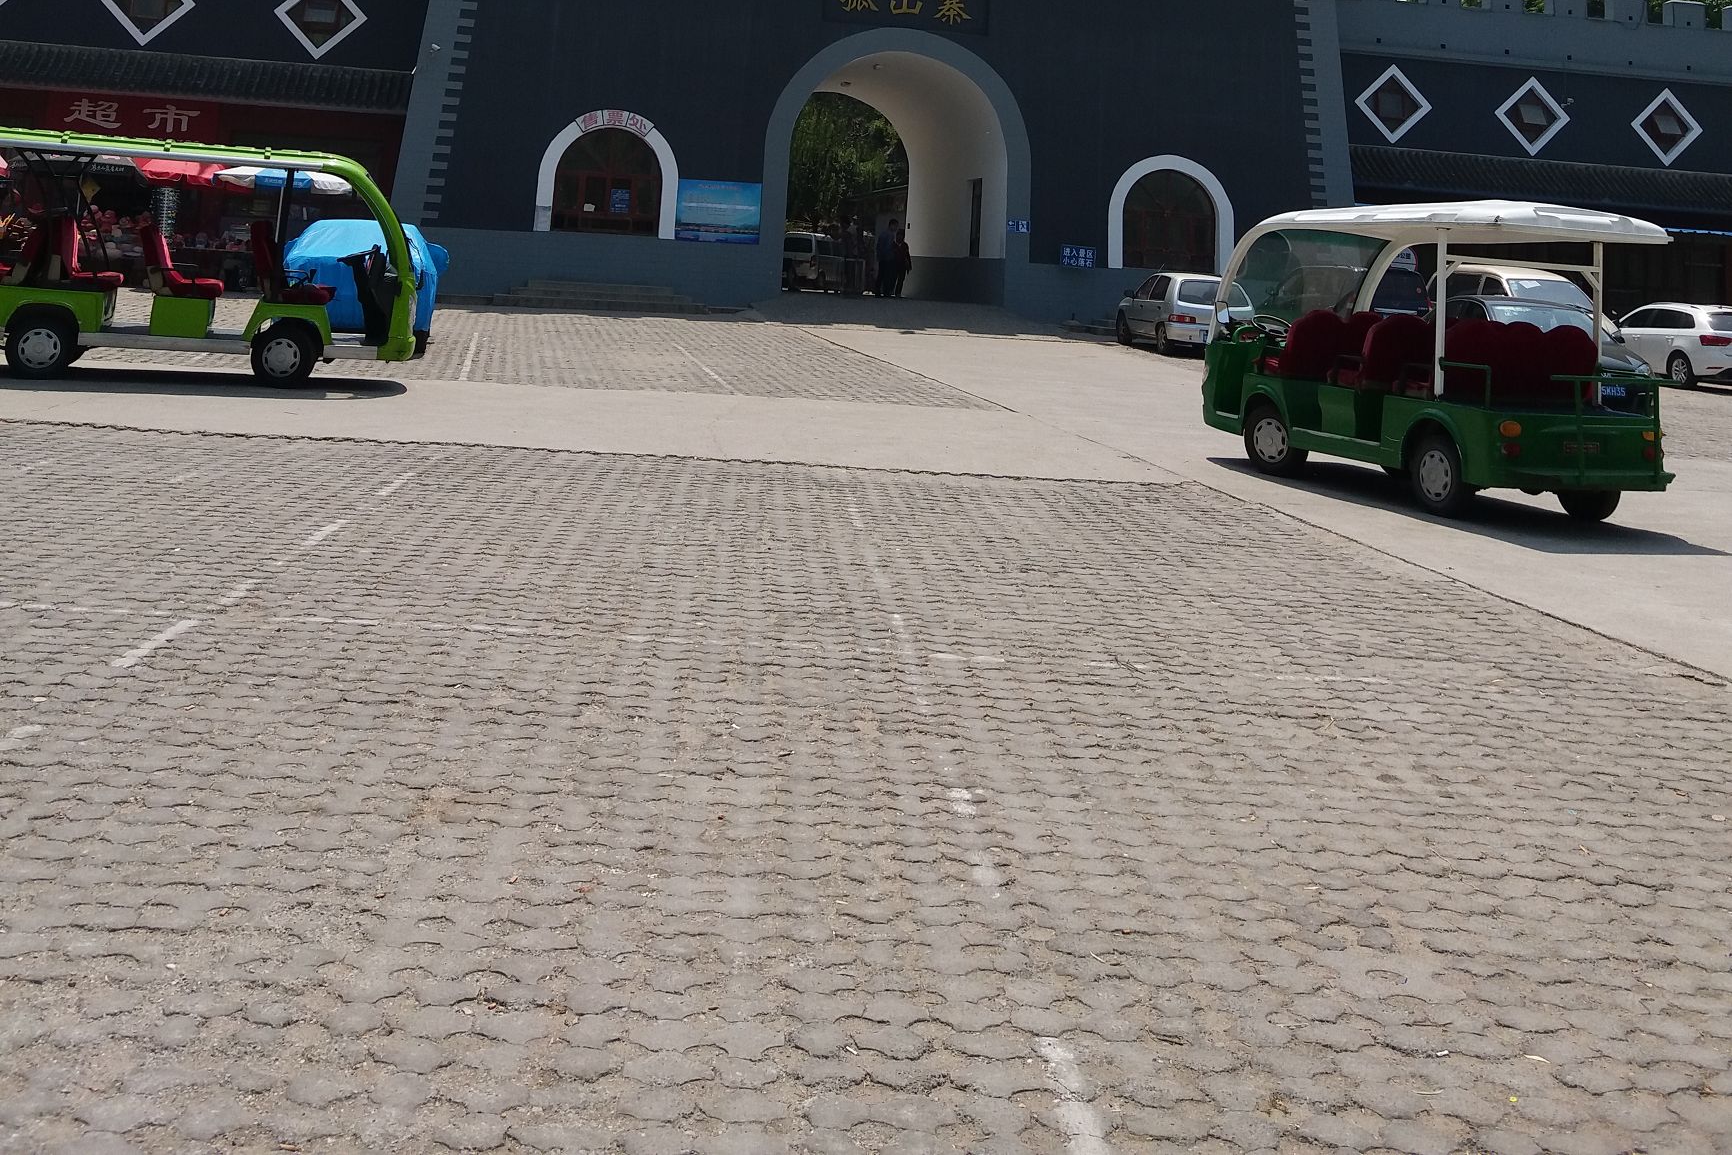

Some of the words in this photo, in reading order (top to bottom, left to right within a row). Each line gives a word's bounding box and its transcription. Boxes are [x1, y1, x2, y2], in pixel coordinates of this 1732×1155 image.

[63, 98, 201, 133] 超市
[581, 110, 649, 135] 售票处
[1063, 247, 1093, 258] 进入景区
[1063, 257, 1093, 267] 小心落石
